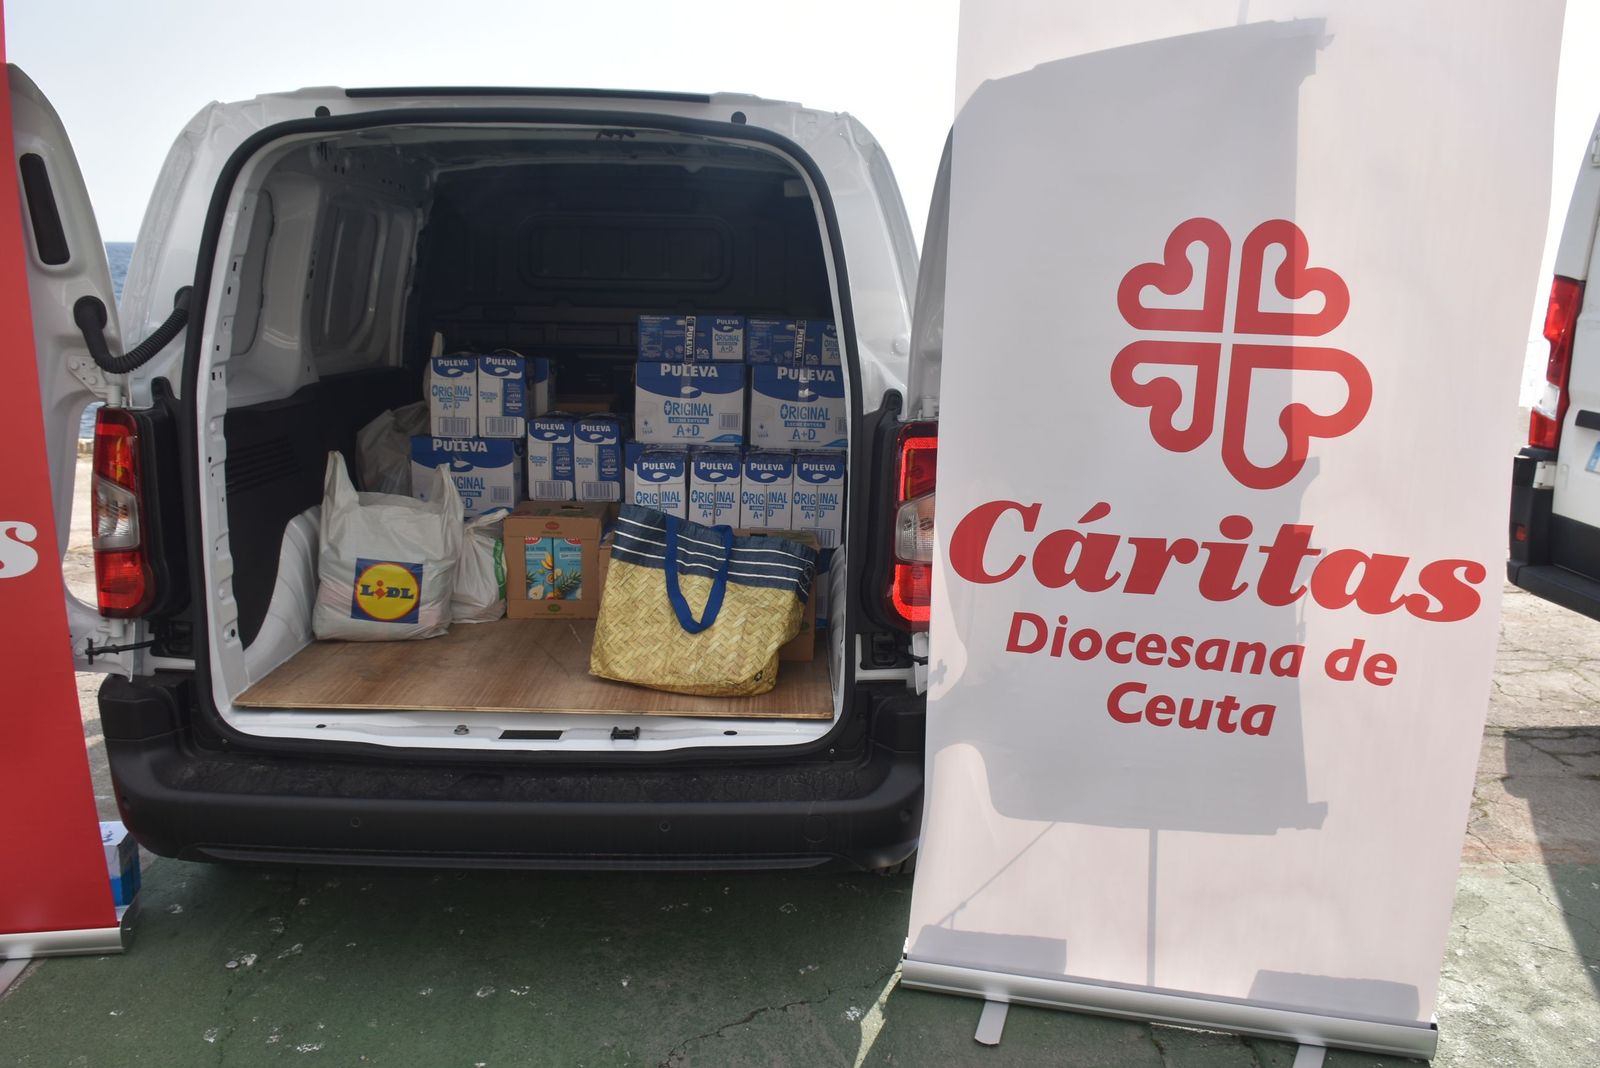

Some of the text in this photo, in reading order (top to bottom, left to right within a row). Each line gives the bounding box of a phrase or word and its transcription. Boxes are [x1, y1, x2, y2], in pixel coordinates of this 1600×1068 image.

[486, 357, 516, 366] PULEVA
[660, 364, 718, 378] PULEVA
[777, 366, 836, 382] PULEVA
[664, 400, 714, 416] ORIGINAL
[780, 404, 830, 420] ORIGINAL
[432, 439, 488, 452] PULEVA
[642, 462, 676, 470] PULEVA
[700, 462, 733, 470] PULEVA
[751, 462, 784, 471] PULEVA
[802, 463, 836, 471] PULEVA
[949, 500, 1486, 622] Cáritas
[1006, 612, 1398, 686] Diocesana de
[1106, 682, 1276, 737] Ceuta
